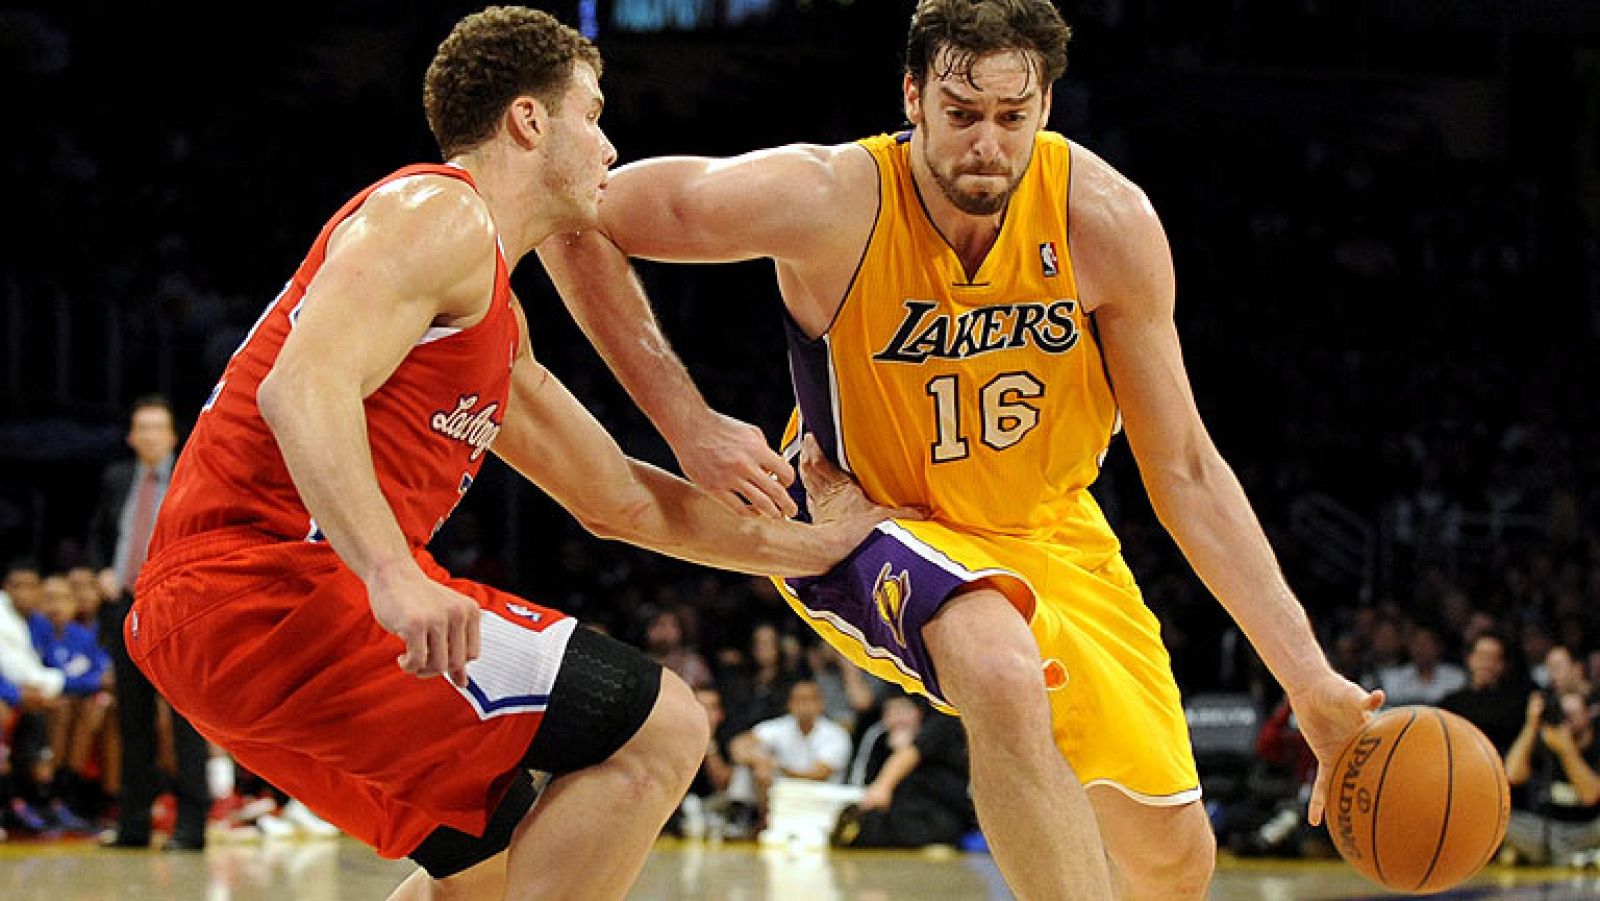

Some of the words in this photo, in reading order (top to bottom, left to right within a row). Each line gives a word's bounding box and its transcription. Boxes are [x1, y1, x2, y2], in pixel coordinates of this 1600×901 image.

[872, 299, 1079, 365] LAKERS
[467, 402, 501, 461] Ang
[926, 370, 1045, 463] 16
